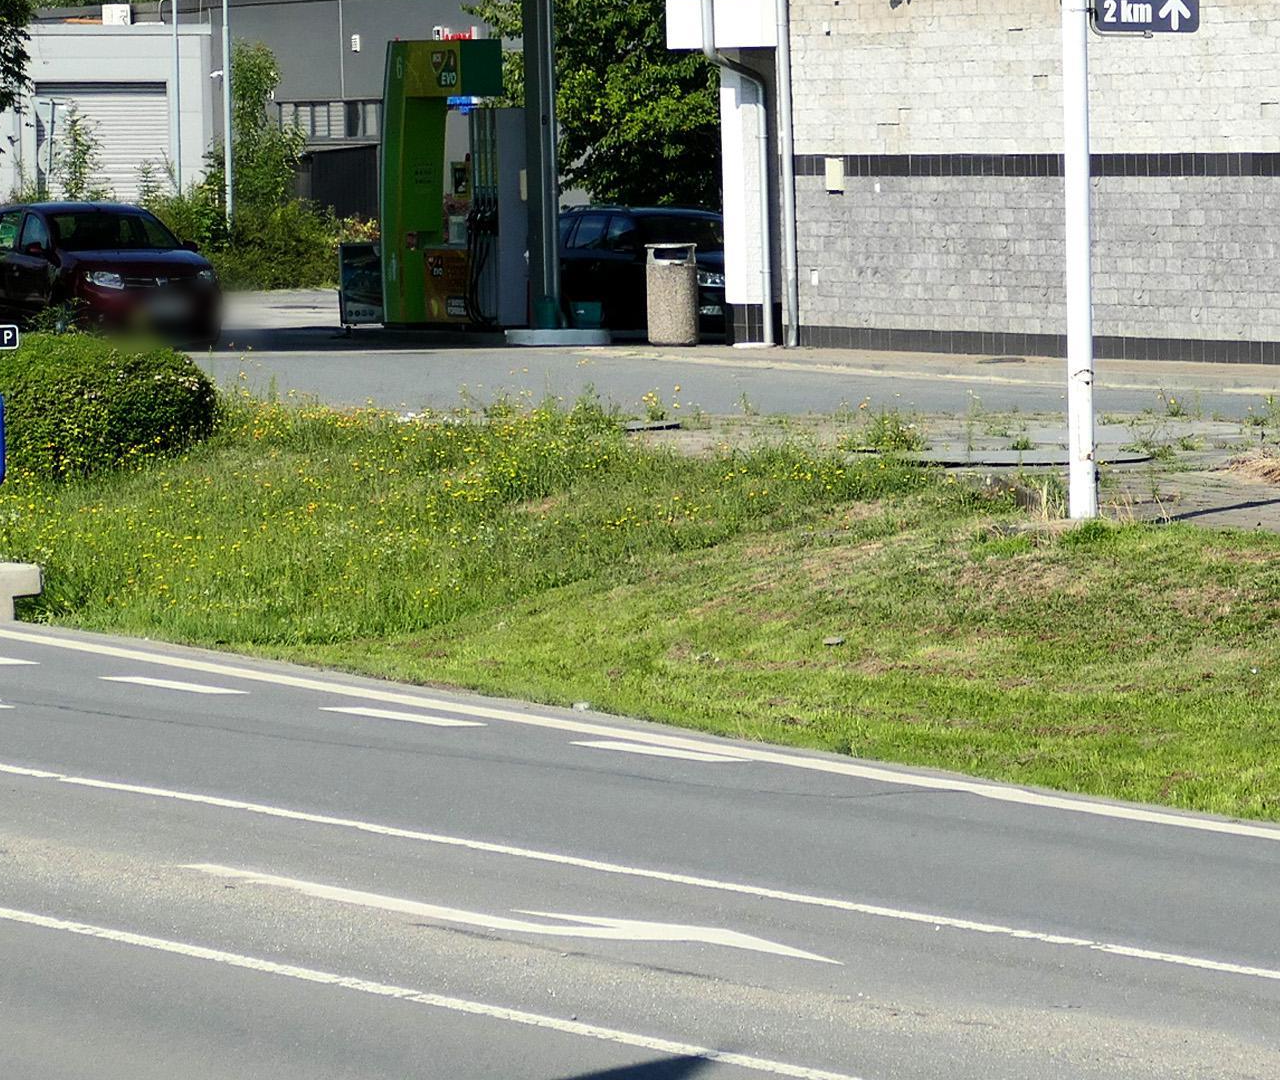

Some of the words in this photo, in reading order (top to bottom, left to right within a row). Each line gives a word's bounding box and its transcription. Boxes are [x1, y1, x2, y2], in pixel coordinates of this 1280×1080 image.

[1103, 0, 1117, 23] 2
[1121, 0, 1153, 24] km
[441, 71, 457, 85] EVO
[3, 329, 13, 345] P
